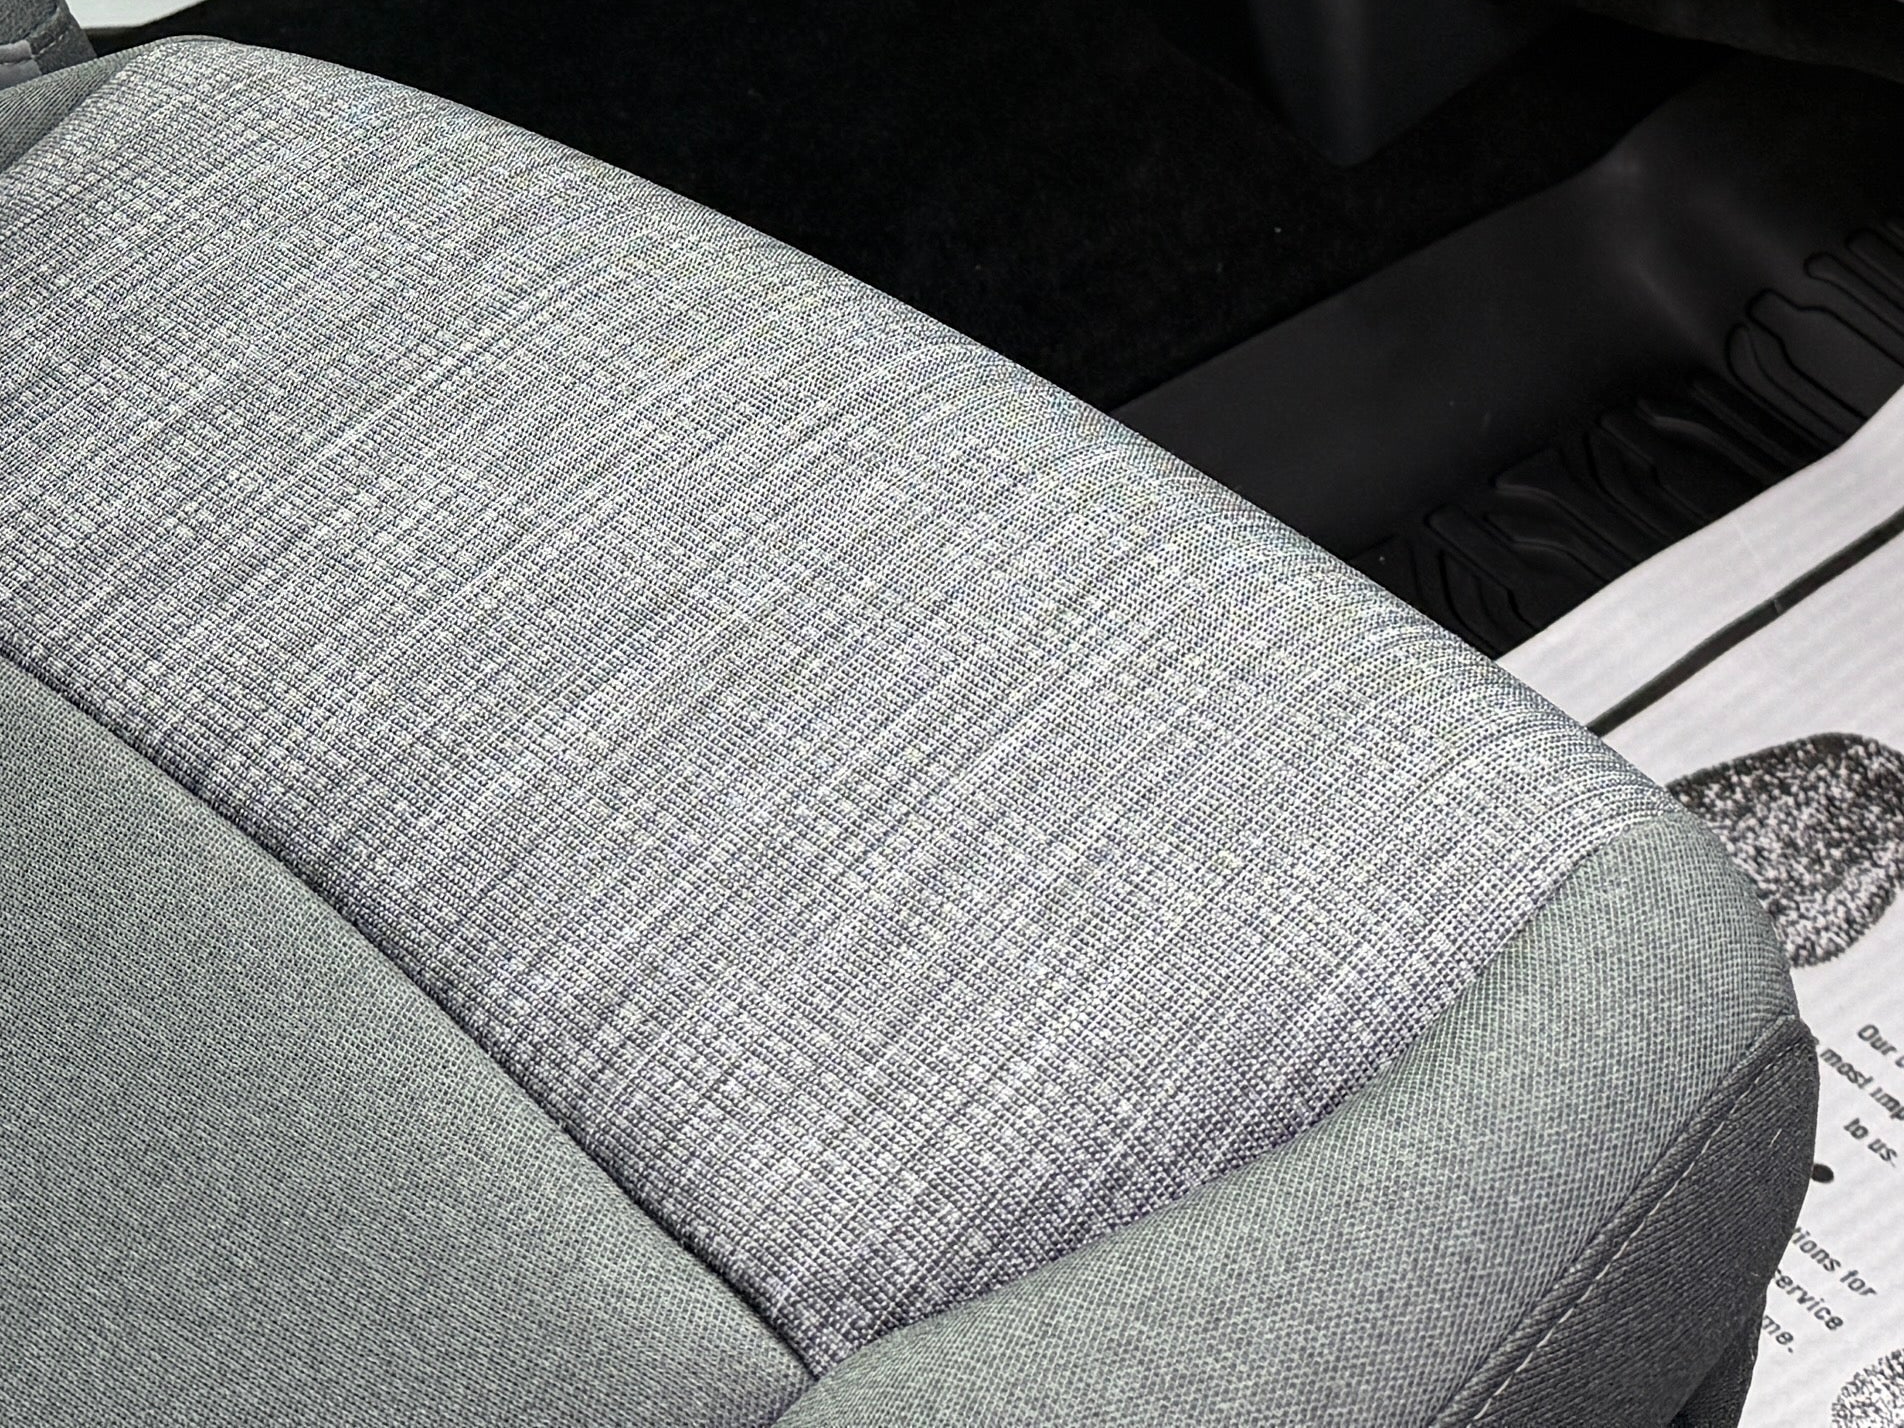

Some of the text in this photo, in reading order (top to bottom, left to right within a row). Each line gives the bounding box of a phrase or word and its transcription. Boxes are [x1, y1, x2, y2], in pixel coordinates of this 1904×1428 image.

[1856, 1023, 1898, 1057] Our
[1819, 1047, 1874, 1090] most
[1843, 1116, 1870, 1141] to
[1839, 1269, 1878, 1297] for
